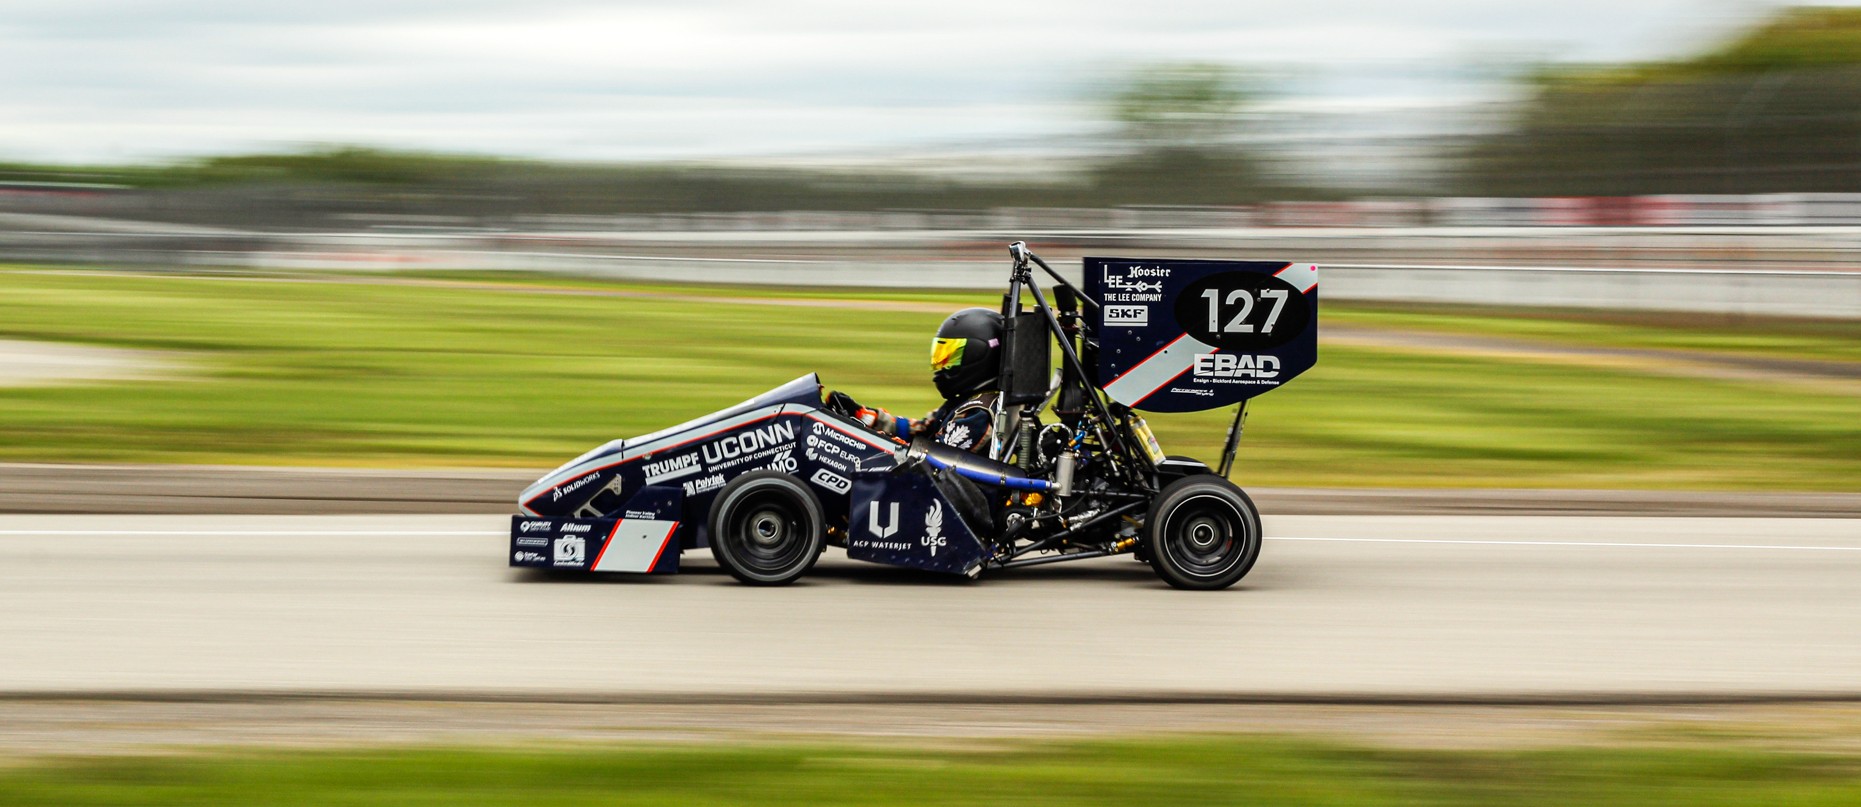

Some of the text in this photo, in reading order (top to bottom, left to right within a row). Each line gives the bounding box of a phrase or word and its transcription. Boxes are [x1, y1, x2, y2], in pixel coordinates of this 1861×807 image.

[1104, 264, 1123, 288] LEE
[1127, 265, 1171, 278] Hoosier
[1104, 293, 1162, 302] THE LEE COMPANY
[1108, 308, 1145, 319] SKF
[1201, 288, 1289, 333] 127
[1193, 353, 1281, 378] EBAD
[702, 420, 795, 465] UCONN
[817, 439, 841, 455] FCP
[642, 452, 700, 478] TRUMPF
[708, 459, 745, 473] UNIVERSITY
[753, 442, 797, 460] CONNECTICUT
[818, 455, 847, 472] HEXAGON
[562, 471, 600, 495] SOLIDWORKS
[695, 473, 726, 489] Polytek
[818, 472, 849, 490] CPD
[560, 522, 592, 532] Altium
[871, 541, 912, 551] WATERJET
[921, 536, 947, 547] USG
